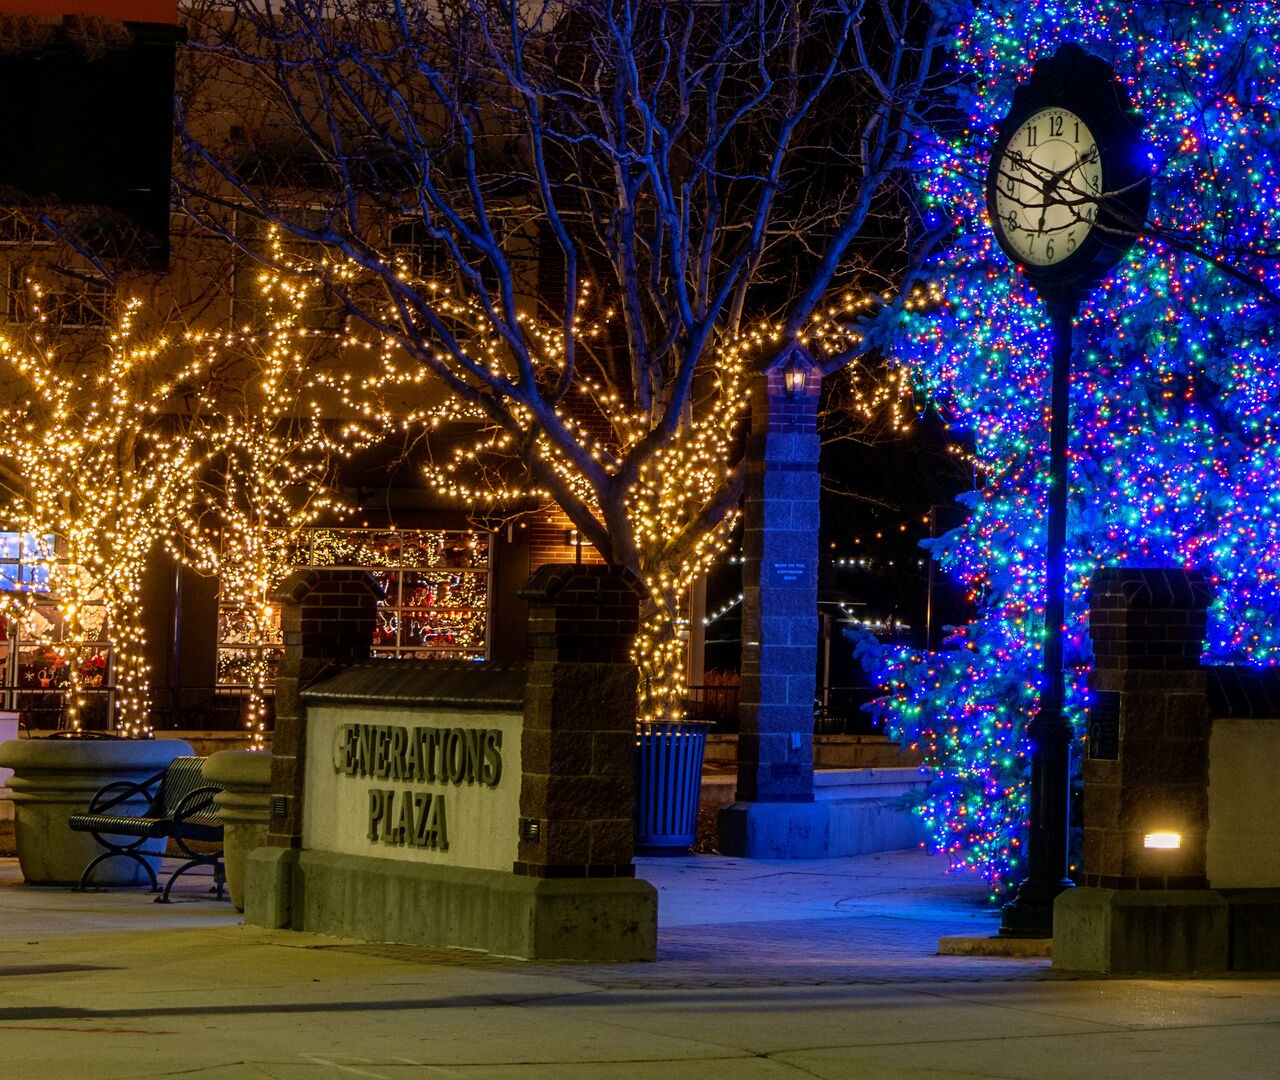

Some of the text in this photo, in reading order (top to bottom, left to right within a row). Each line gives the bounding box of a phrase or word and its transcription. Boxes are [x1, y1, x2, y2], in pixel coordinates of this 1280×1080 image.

[1027, 125, 1037, 147] 11
[1049, 115, 1064, 137] 12
[1073, 121, 1080, 143] 1
[1010, 150, 1022, 171] 10
[1089, 143, 1098, 164] 2
[1006, 179, 1015, 197] 9
[1091, 175, 1099, 196] 3
[1009, 210, 1018, 232] 8
[1025, 233, 1035, 255] 7
[1046, 238, 1055, 260] 6
[1066, 231, 1076, 252] 5
[367, 788, 450, 853] PLAZA
